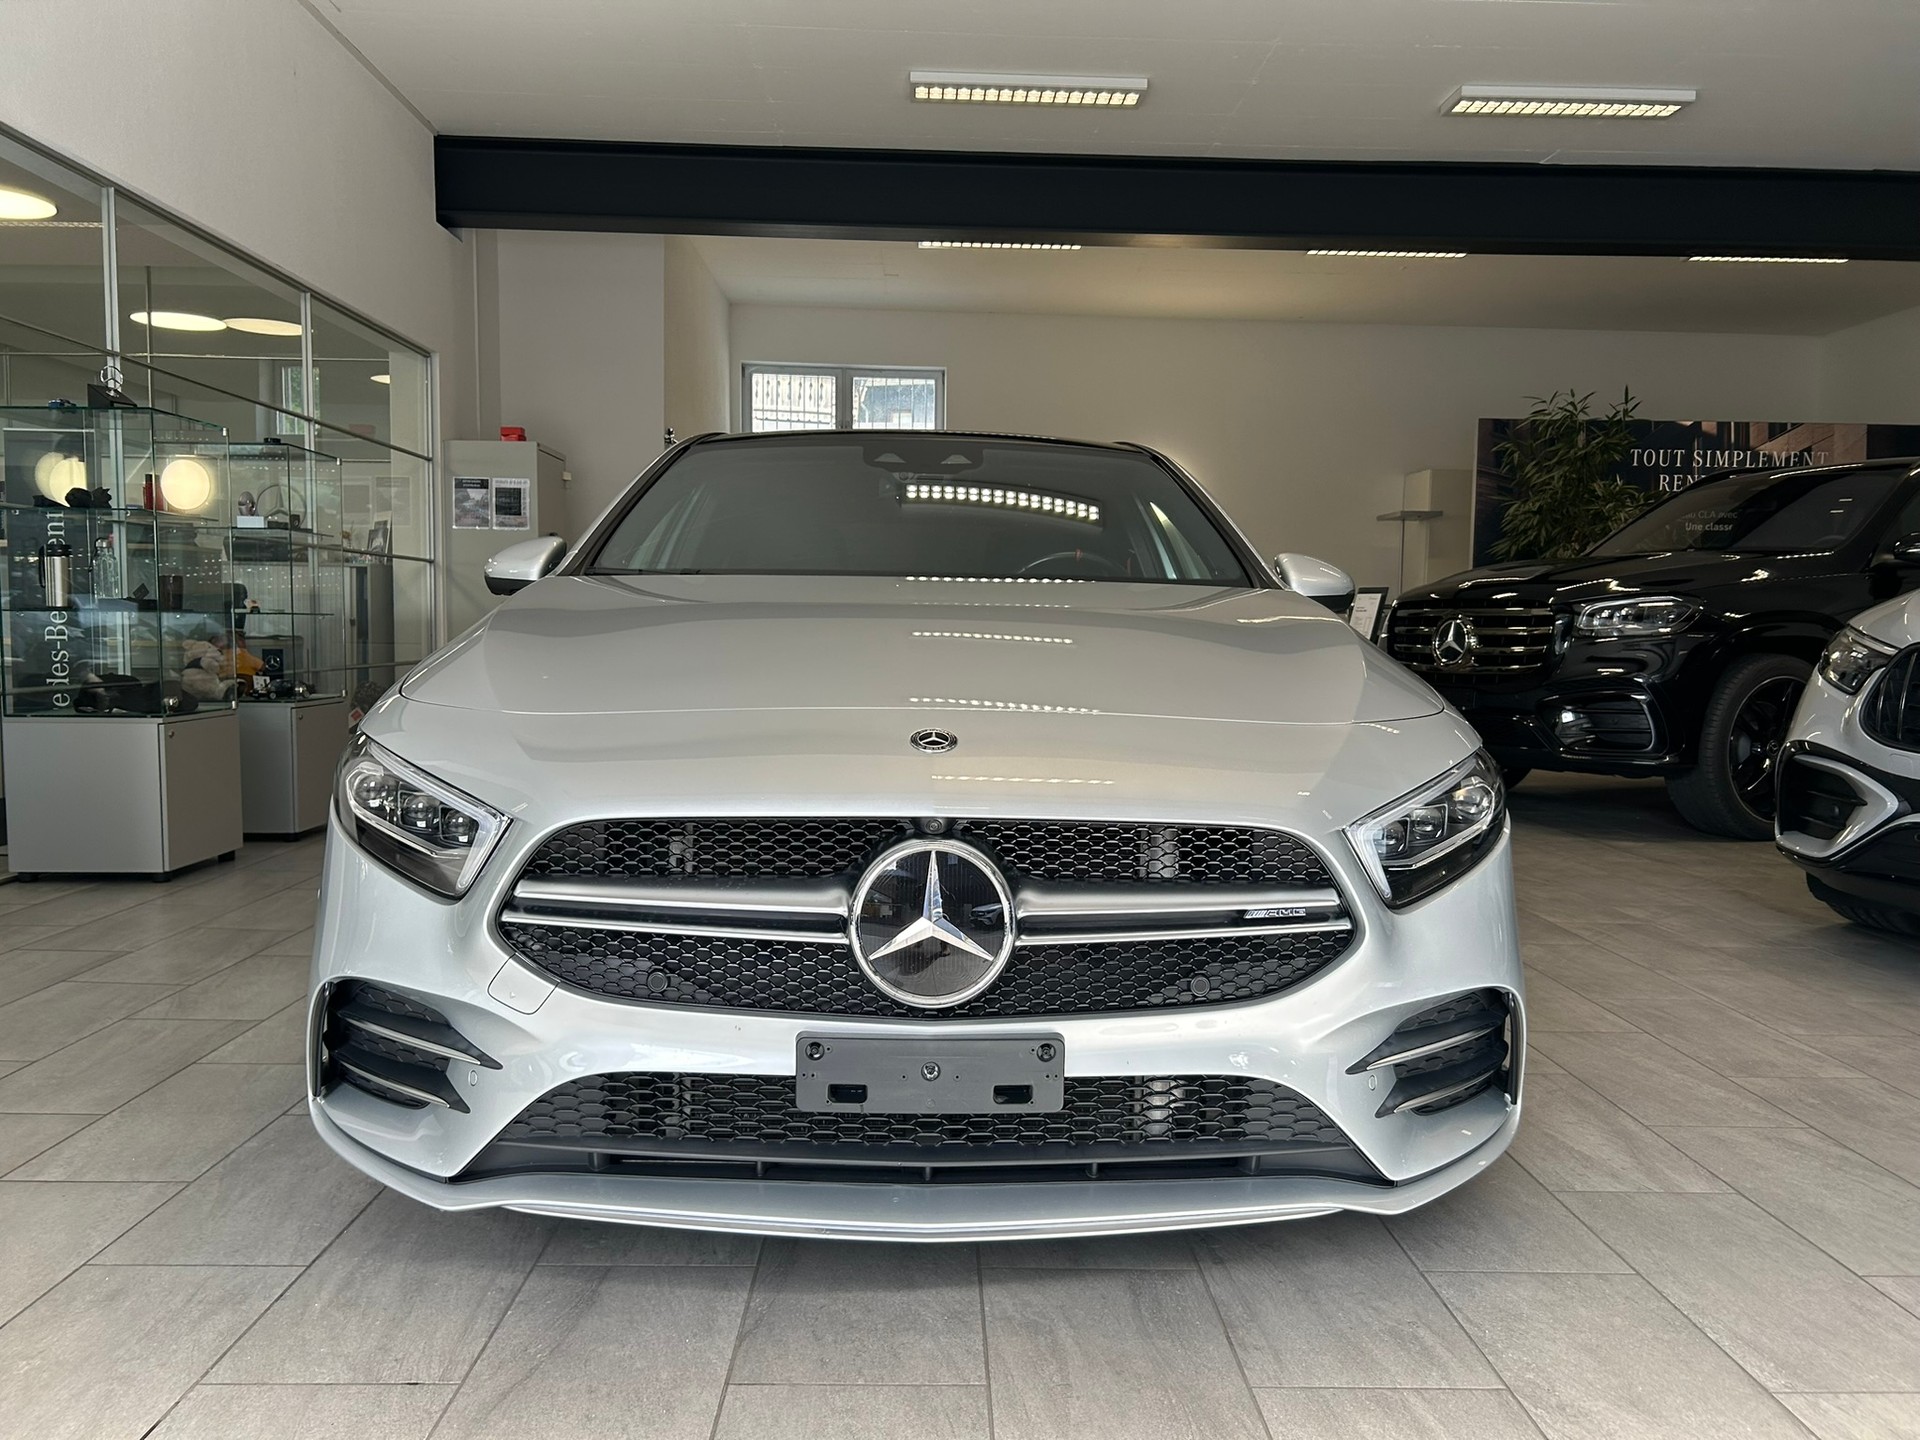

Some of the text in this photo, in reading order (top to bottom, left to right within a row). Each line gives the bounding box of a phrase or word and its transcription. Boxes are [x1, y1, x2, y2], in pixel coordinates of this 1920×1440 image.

[1630, 448, 1829, 468] TOUT SIMPLEMENT
[1685, 522, 1703, 531] Une
[1262, 908, 1306, 918] AMG
